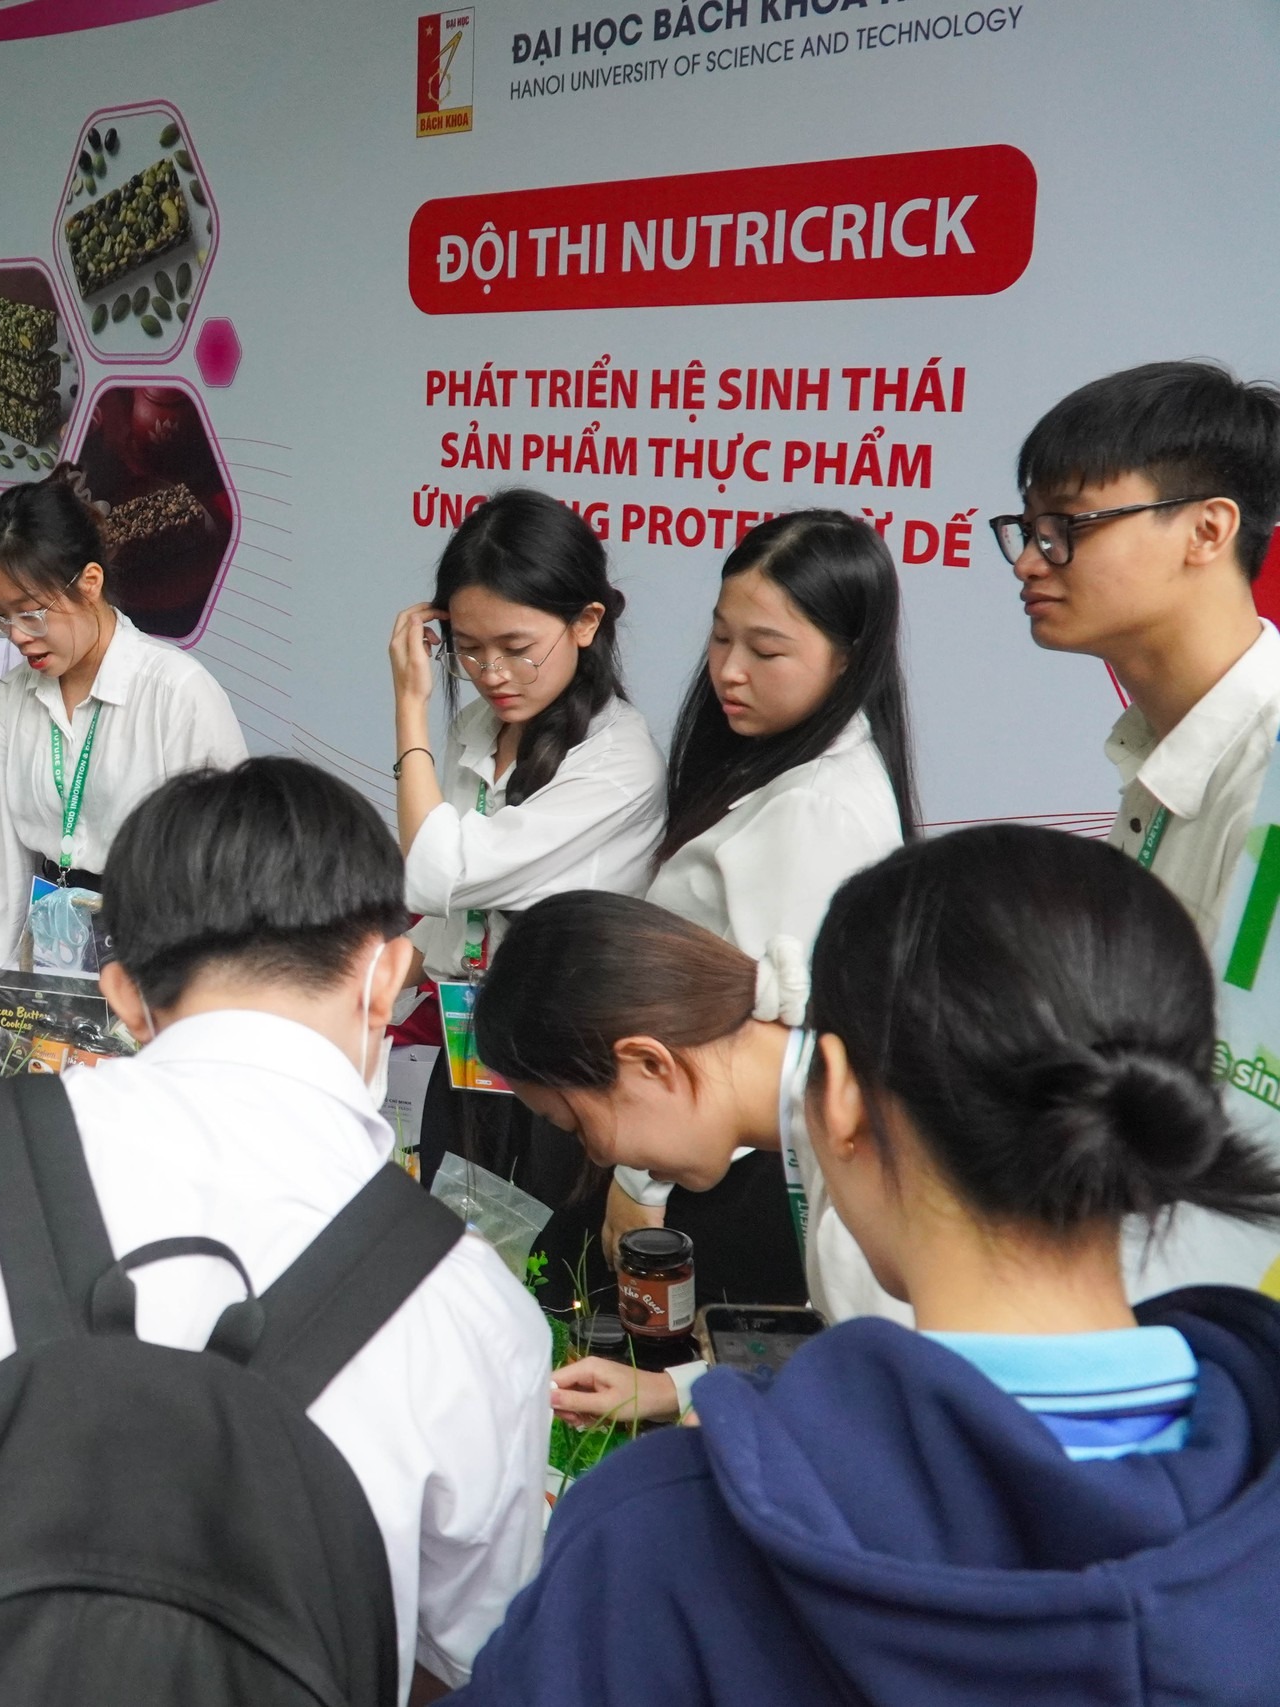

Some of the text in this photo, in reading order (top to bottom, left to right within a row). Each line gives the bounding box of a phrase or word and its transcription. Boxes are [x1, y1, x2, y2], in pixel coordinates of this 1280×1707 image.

[446, 16, 469, 30] ĐẠI HỌC
[512, 27, 561, 66] ĐẠI
[572, 14, 642, 56] HỌC
[653, 0, 748, 41] BÁCH
[510, 6, 1023, 100] HANOI UNIVERSITY OF SCIENCE AND TECHNOLOGY
[420, 112, 469, 131] BÁCH KHOA
[437, 195, 978, 295] ĐỘI THI NUTRICRICK
[426, 354, 966, 423] PHÁT TRIỂN HỆ SINH THÁI
[440, 420, 933, 492] SẢN PHẨM THỰC PHẨM
[622, 504, 784, 549] PROTE
[902, 508, 978, 568] DẾ
[52, 729, 61, 780] FUTURE OF
[70, 762, 87, 810] INNOVATION
[66, 812, 76, 834] FOOD
[0, 1018, 34, 1031] Cookies
[1233, 1060, 1280, 1105] sin
